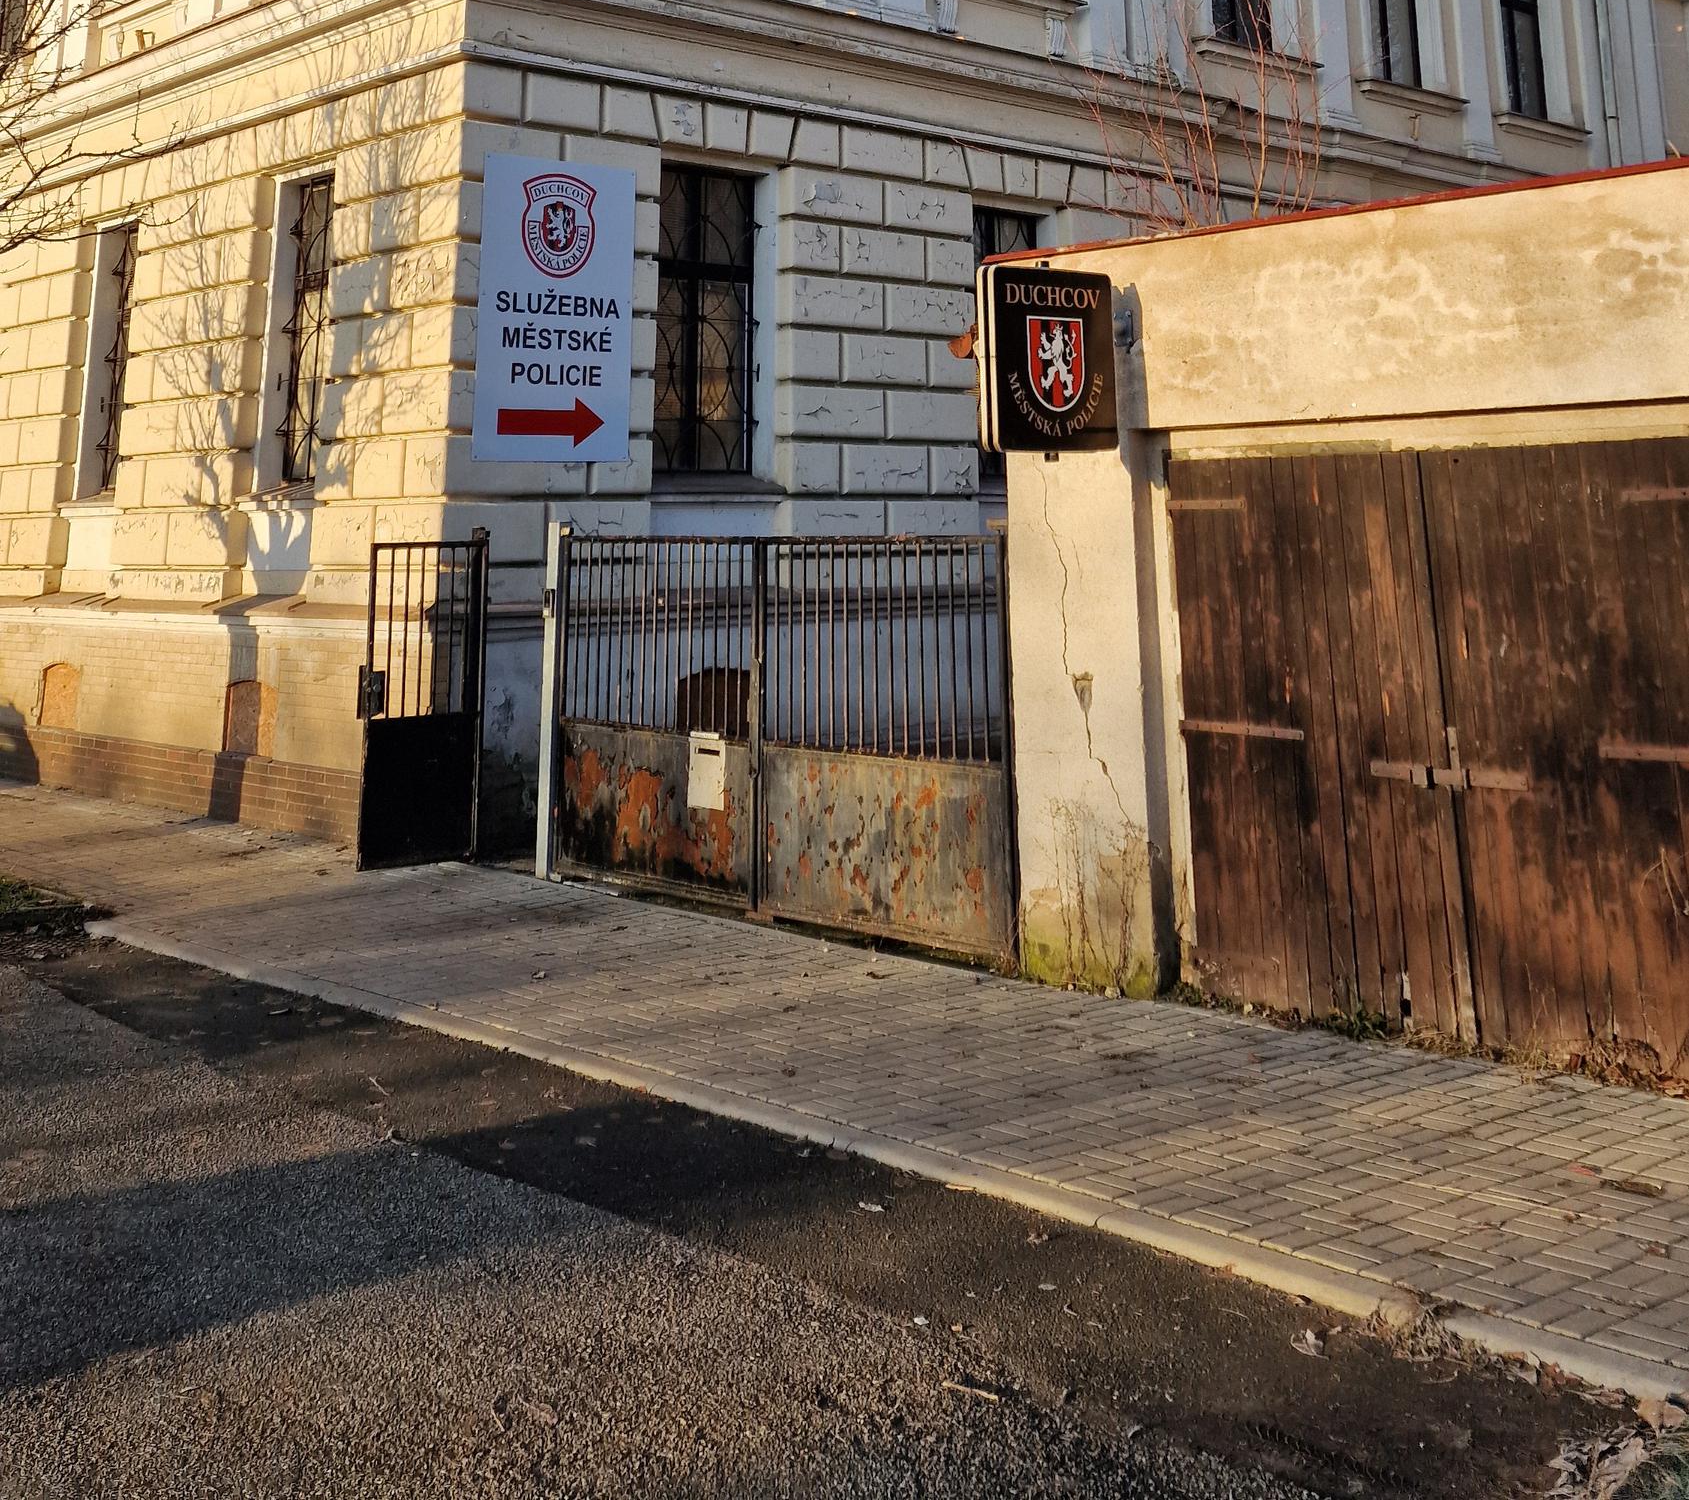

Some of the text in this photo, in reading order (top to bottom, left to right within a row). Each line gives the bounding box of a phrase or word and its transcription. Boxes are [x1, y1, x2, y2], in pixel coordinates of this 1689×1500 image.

[533, 183, 588, 201] DUCHCOV
[563, 229, 588, 269] POLICIE
[495, 288, 620, 319] SLUŽEBNA
[1005, 283, 1100, 309] DUCHCOV
[502, 322, 612, 353] MĚSTSKÉ
[511, 362, 602, 387] POLICIE
[1008, 371, 1104, 437] MĚSTSKÁ POLICIE
